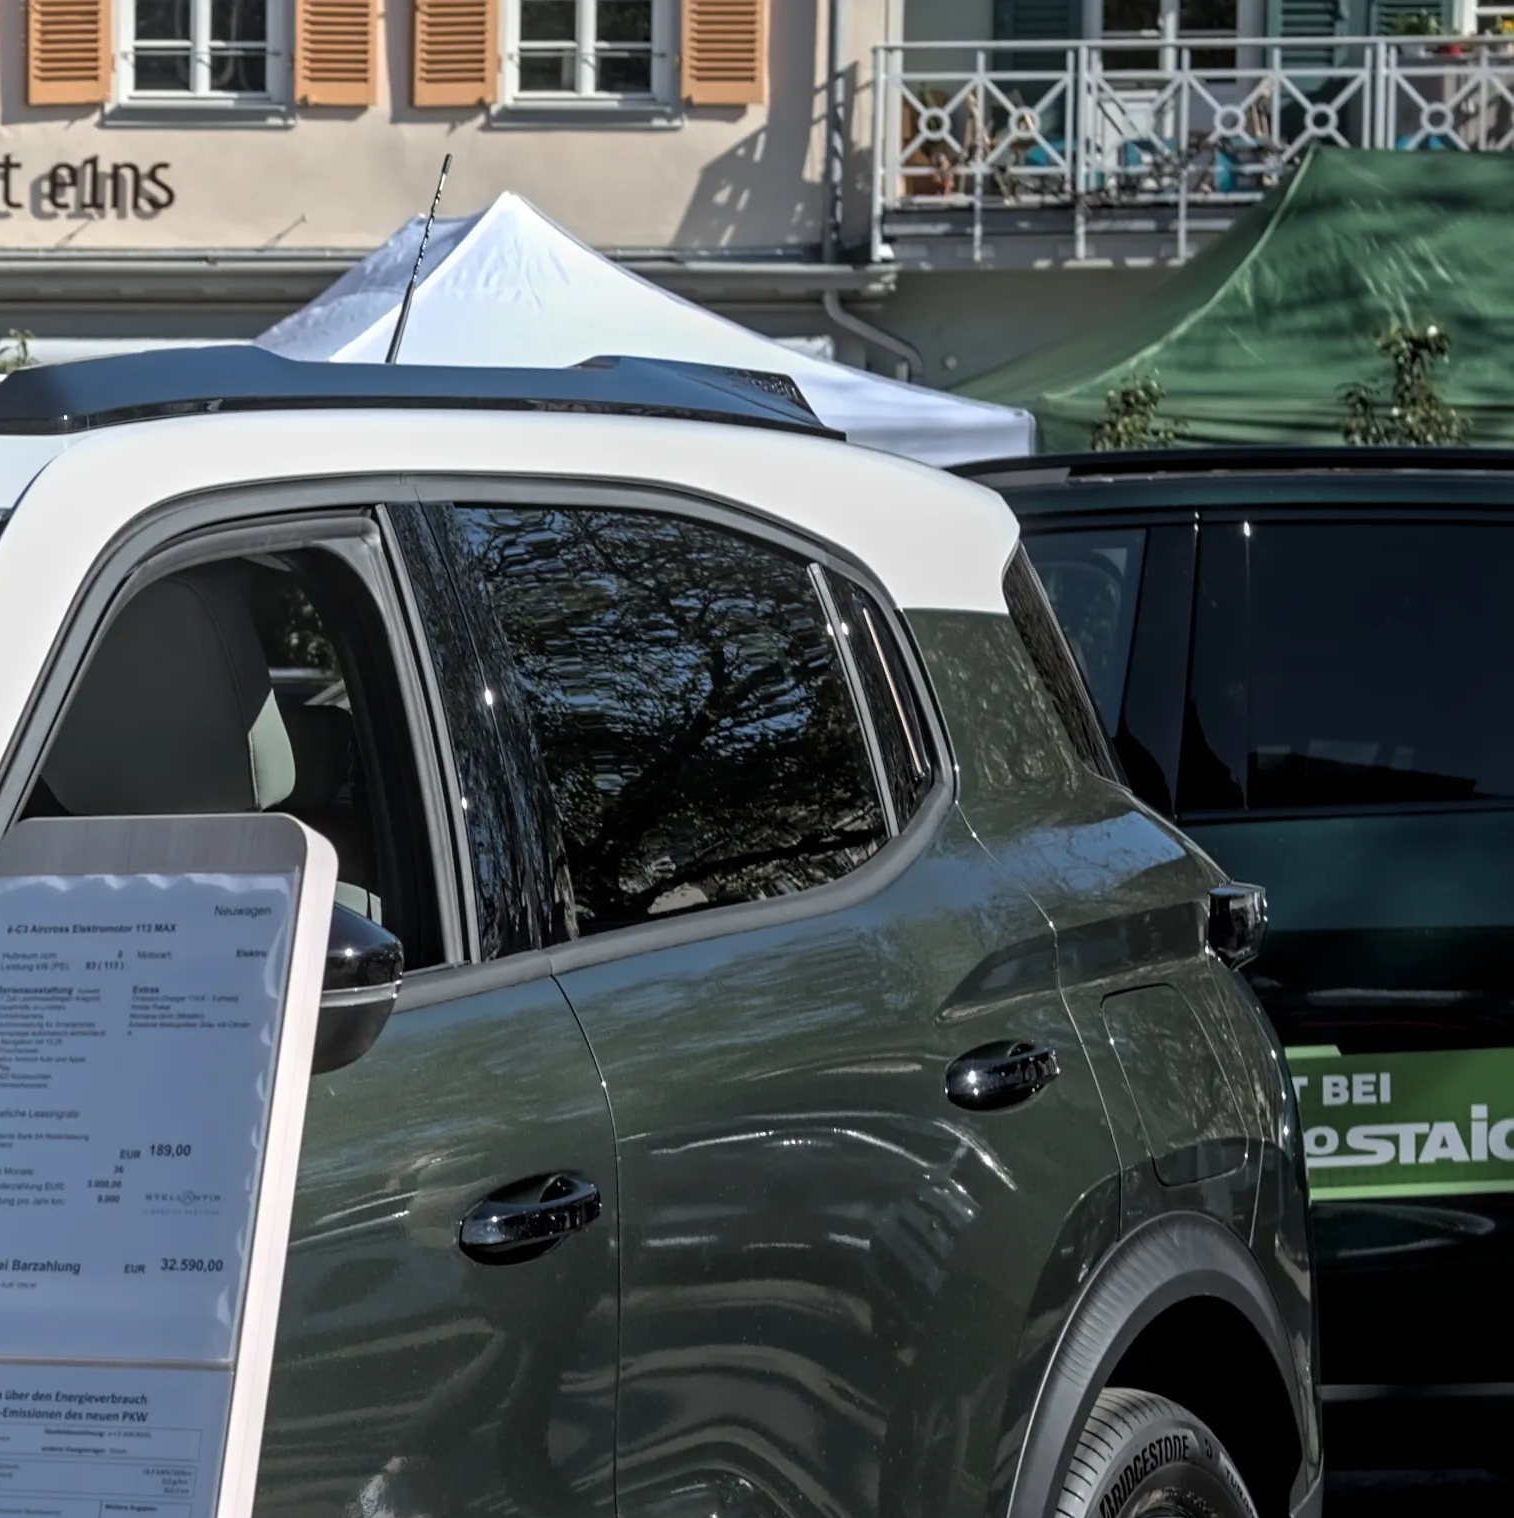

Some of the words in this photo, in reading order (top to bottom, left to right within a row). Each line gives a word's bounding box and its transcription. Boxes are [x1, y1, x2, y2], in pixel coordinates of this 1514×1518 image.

[214, 905, 271, 919] Neuwagen
[30, 923, 70, 934] Aircross
[72, 923, 132, 934] Elektromotor
[136, 924, 151, 933] 113
[154, 923, 177, 933] MAX
[236, 949, 267, 958] Elektro
[1322, 1073, 1391, 1106] BEI
[119, 1149, 141, 1159] EUR
[150, 1144, 192, 1158] 189,00
[11, 1260, 81, 1275] Barzahlung
[124, 1264, 146, 1274] EUR
[160, 1258, 224, 1273] 32.590,00
[5, 1389, 29, 1401] über
[32, 1390, 52, 1402] den
[55, 1391, 148, 1405] Energieverbrauch
[64, 1408, 82, 1420] des
[85, 1411, 119, 1422] neuen
[122, 1411, 149, 1423] PKW
